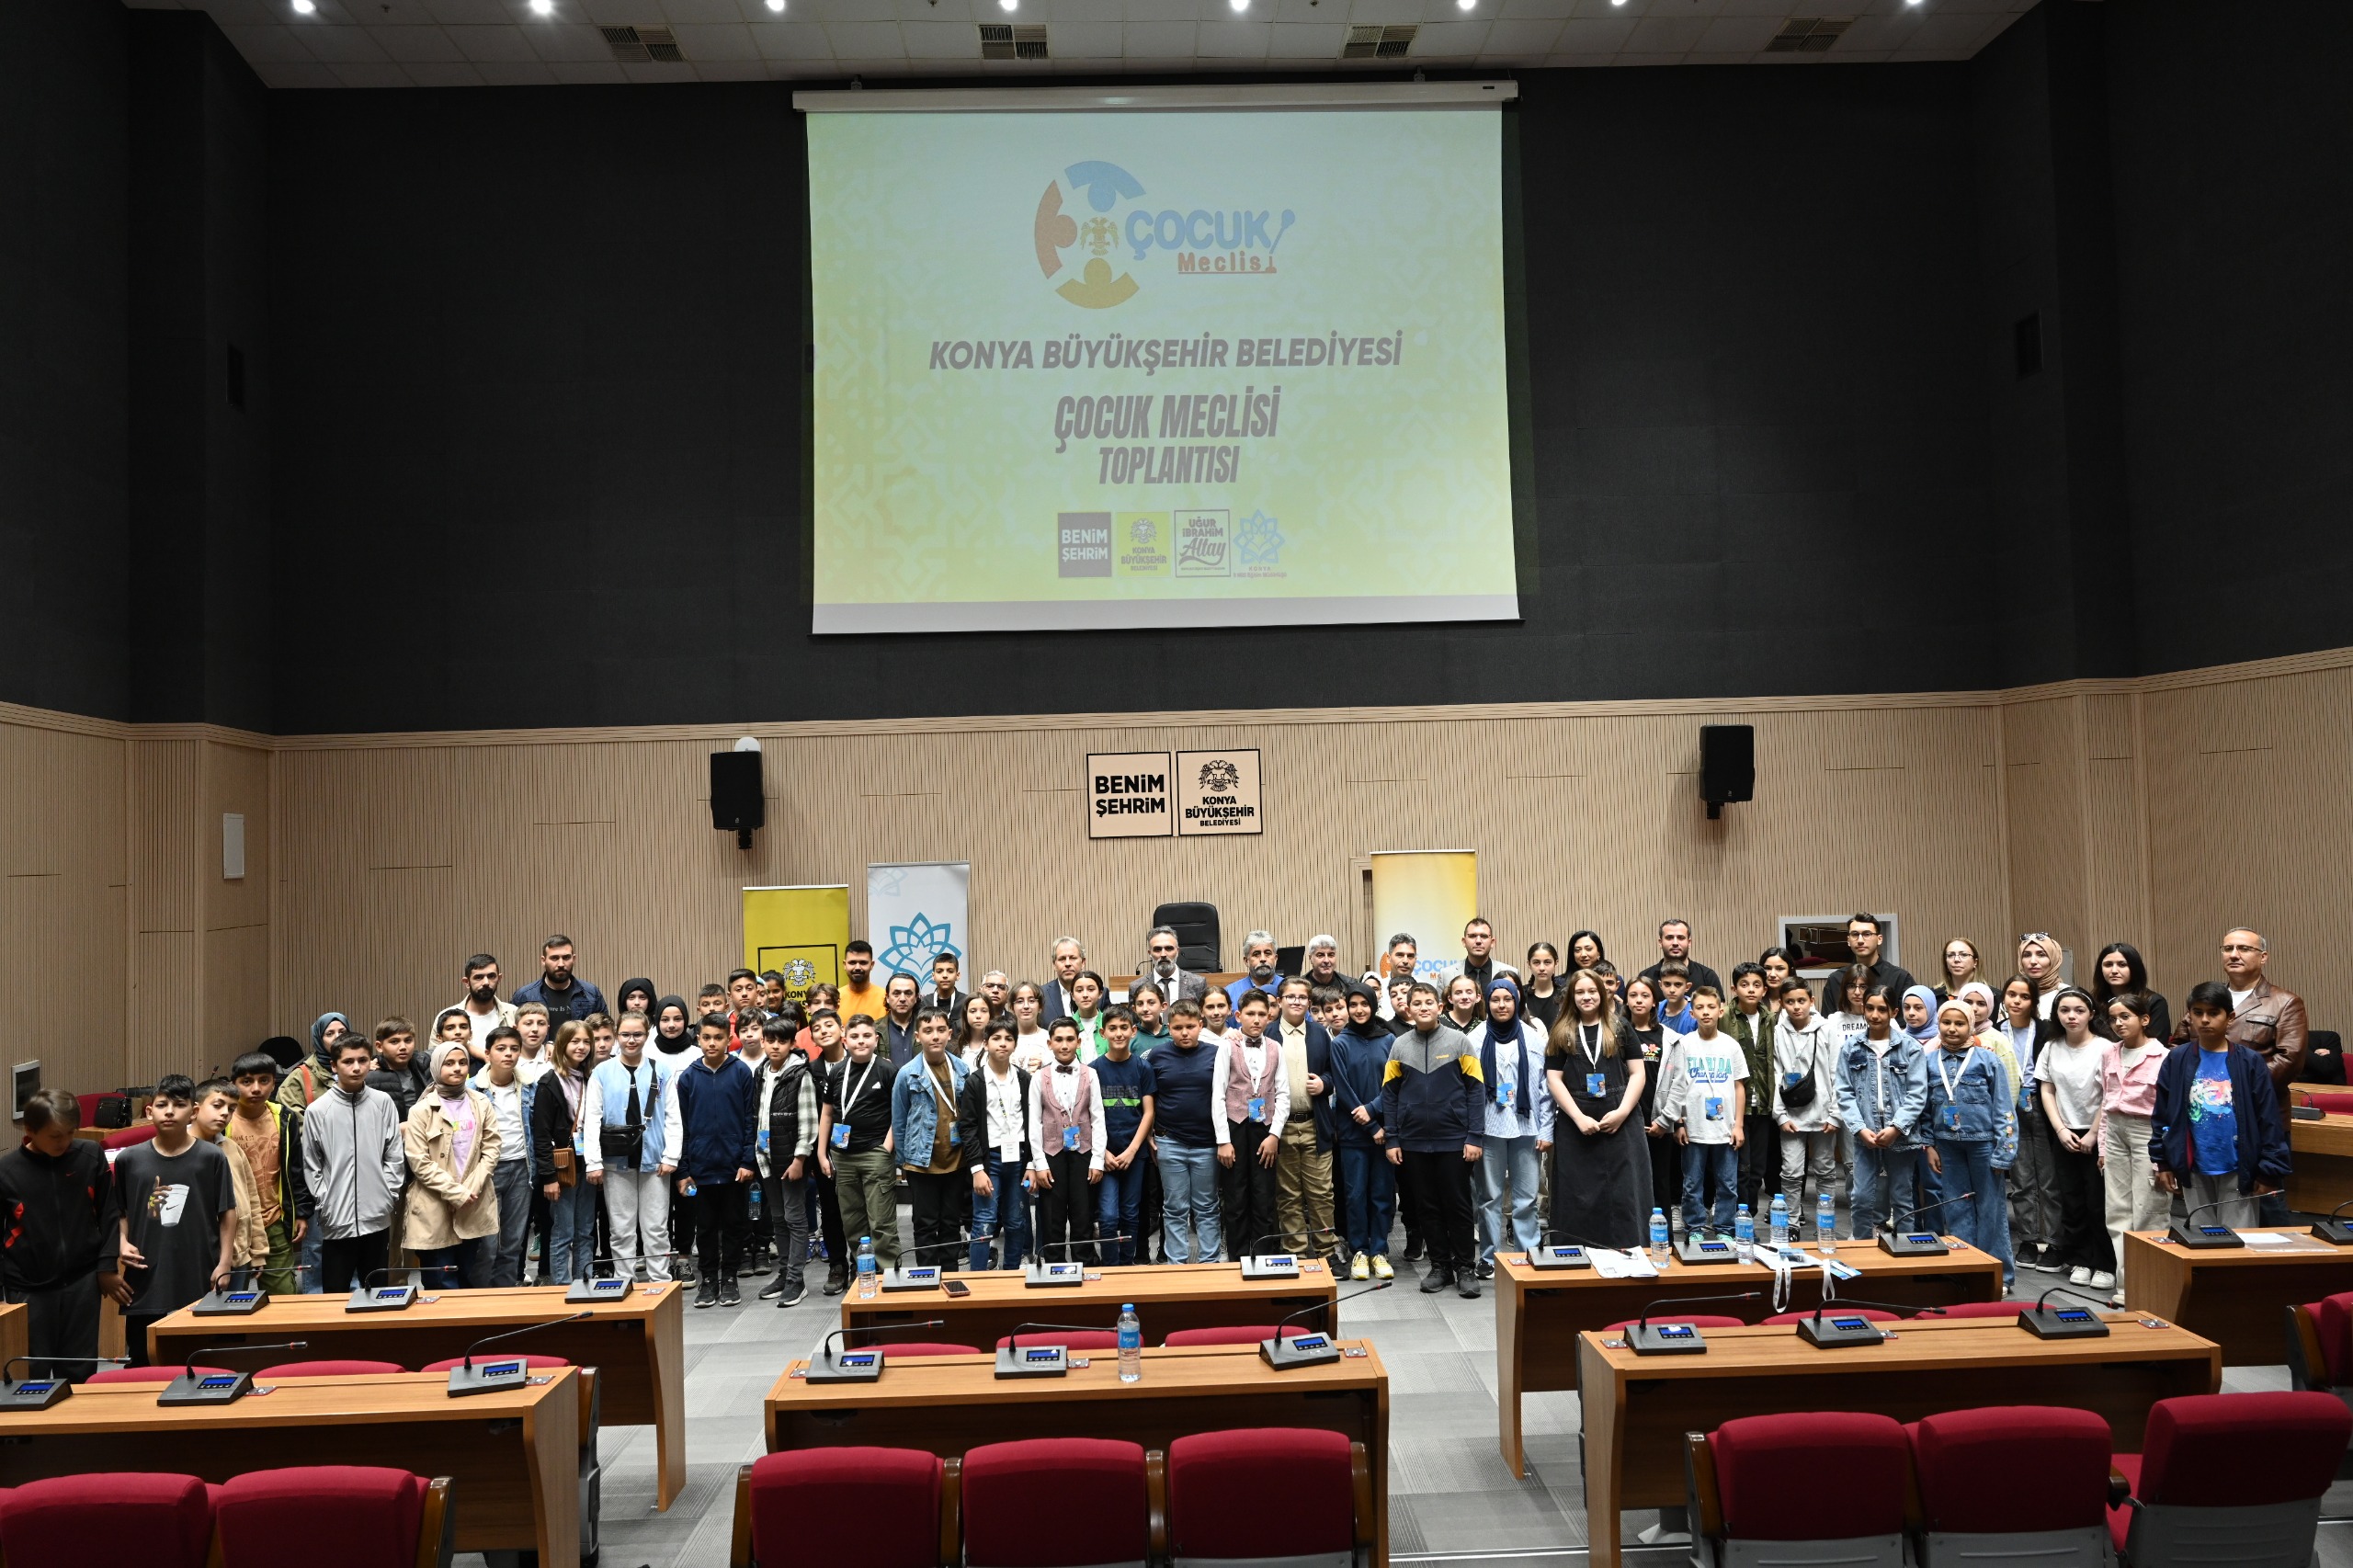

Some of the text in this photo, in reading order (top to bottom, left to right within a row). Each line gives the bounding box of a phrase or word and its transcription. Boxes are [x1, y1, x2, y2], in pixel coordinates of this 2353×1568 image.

[1125, 210, 1272, 261] ÇOCUK
[929, 329, 1404, 377] KONYA BÜYÜKŞEHİR BELEDİYESİ
[1054, 385, 1281, 454] ÇOCUK MECLİSİ
[1098, 445, 1240, 484] TOPLANTISI
[1188, 517, 1217, 528] UĞUR
[1131, 546, 1155, 554] KONYA
[1179, 538, 1227, 566] Altay
[1202, 795, 1237, 805] KONYA
[1185, 804, 1255, 819] BÜYÜKŞEHİR
[1199, 818, 1241, 826] BELEDİYESİ
[785, 990, 807, 999] KONY
